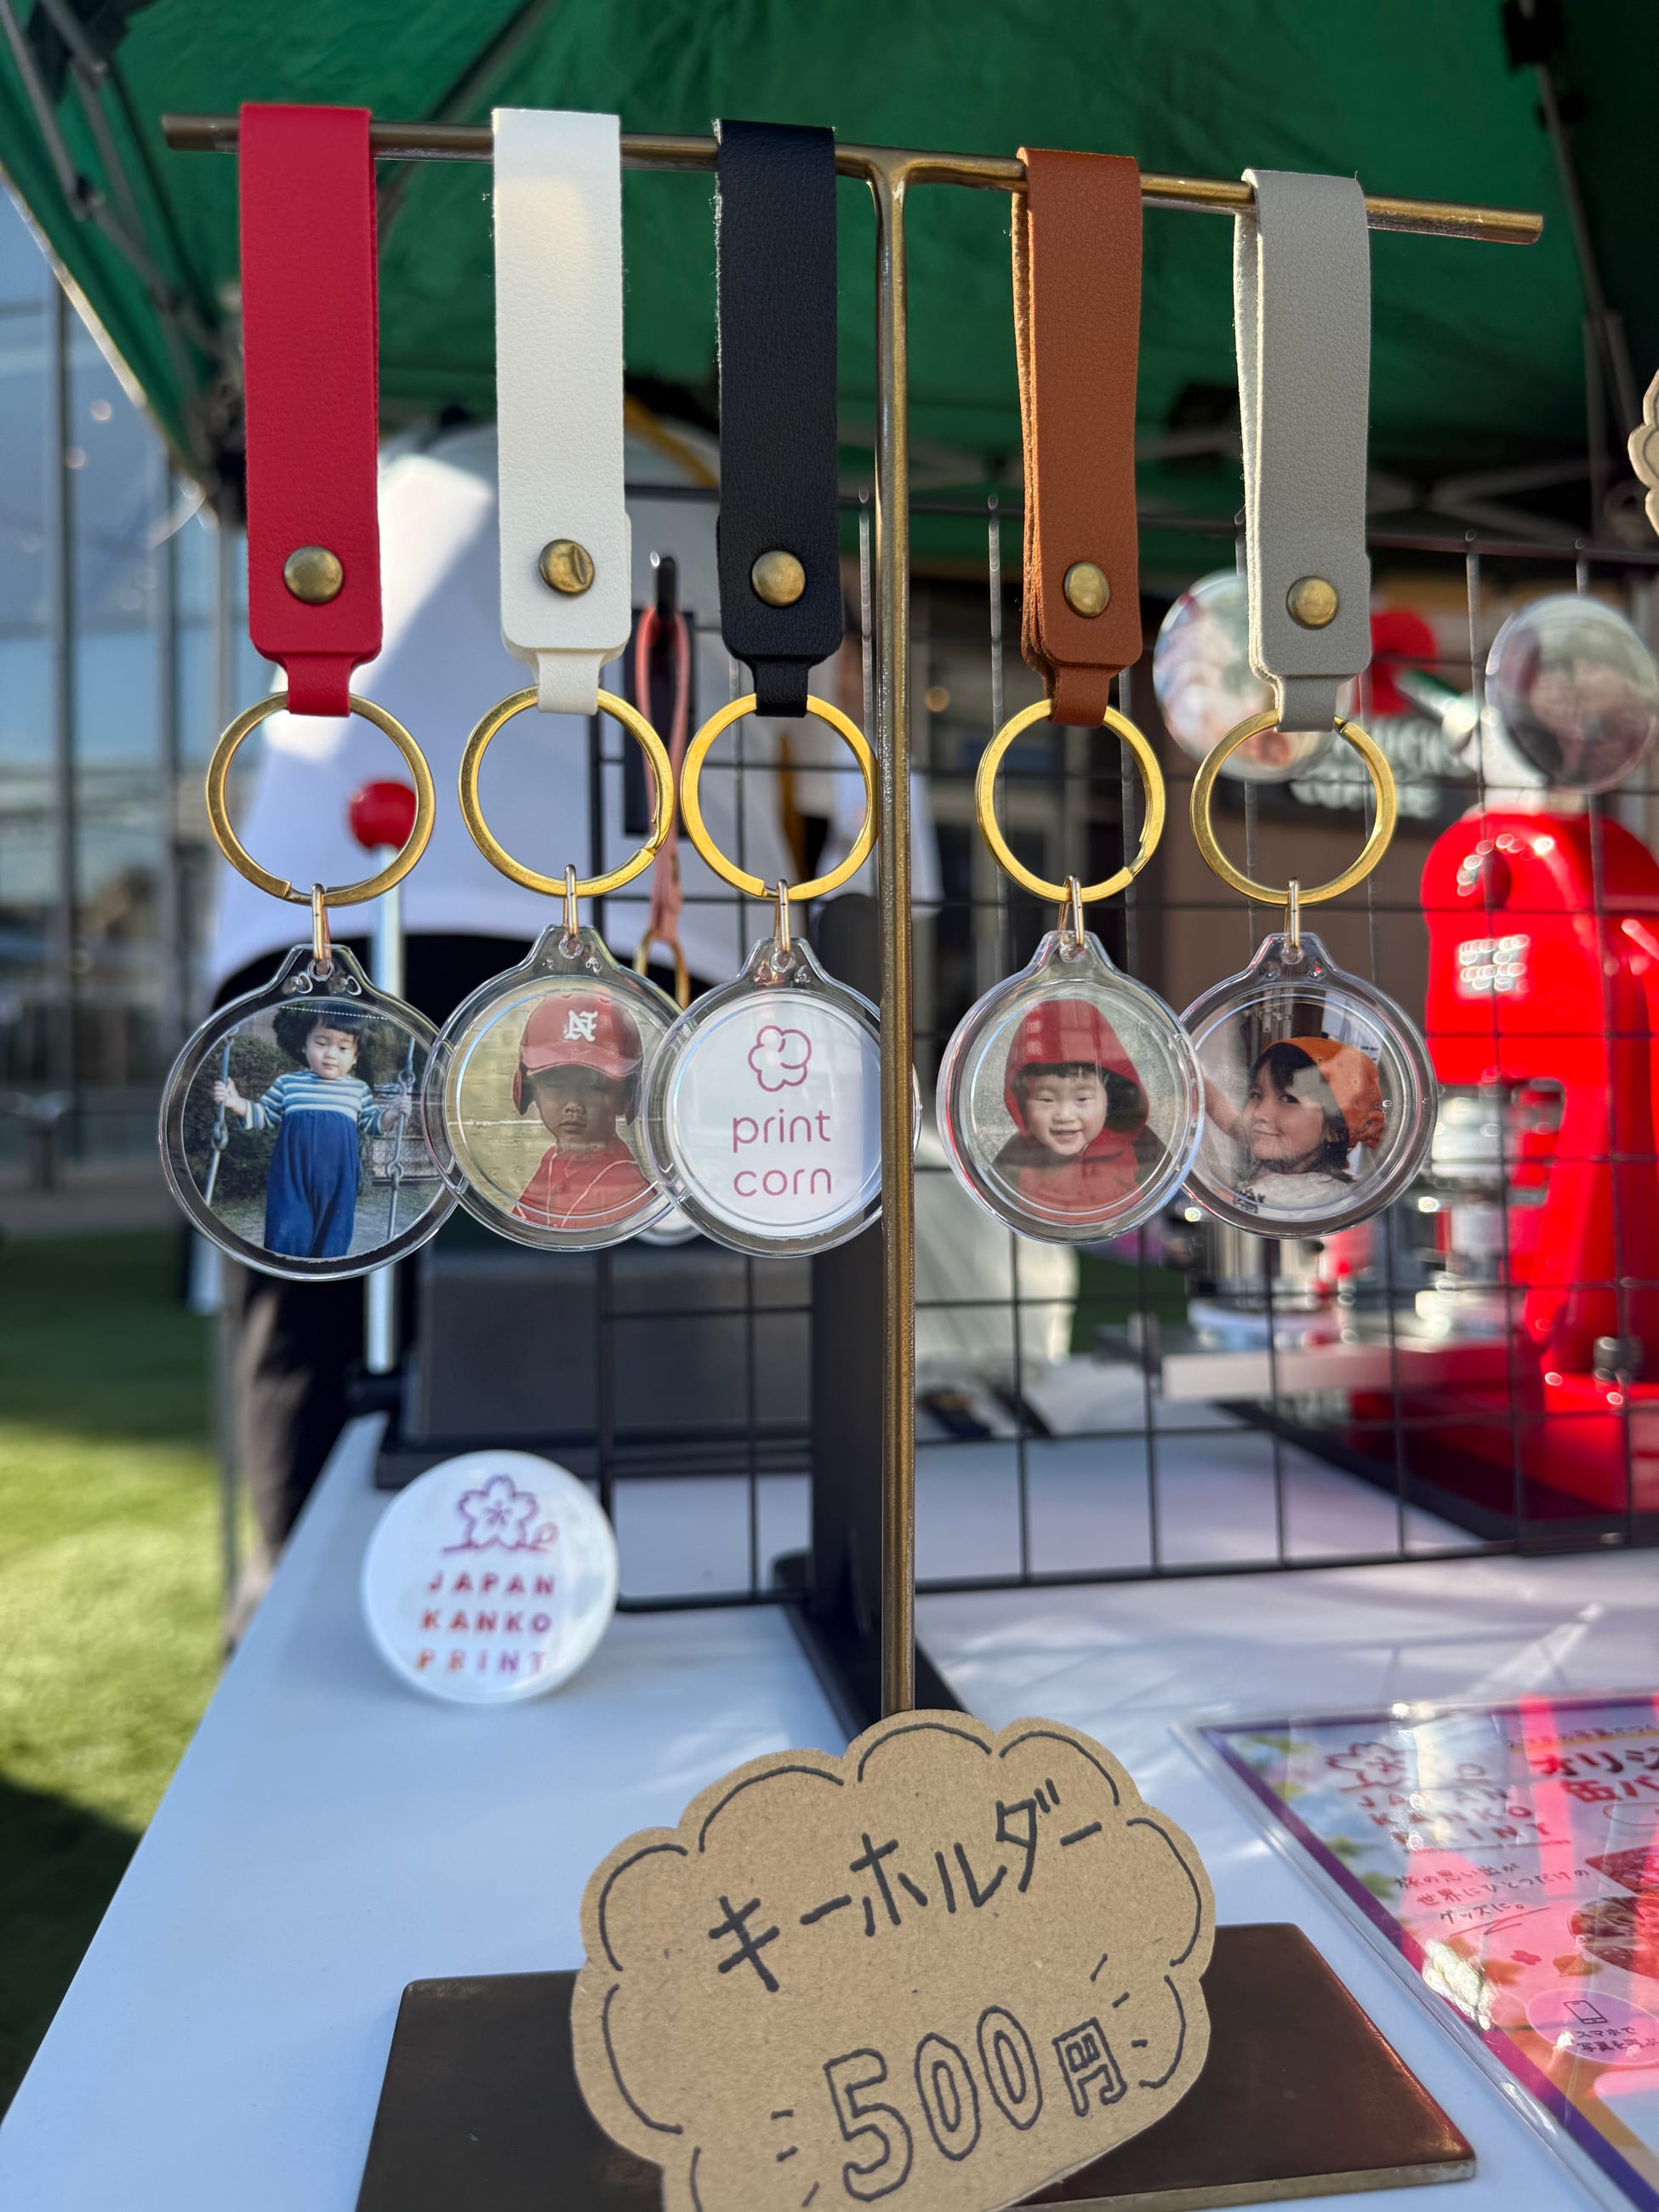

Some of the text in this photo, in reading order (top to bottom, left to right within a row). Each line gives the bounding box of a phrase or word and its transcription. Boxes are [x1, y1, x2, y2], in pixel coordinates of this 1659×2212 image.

[733, 1108, 831, 1154] print
[733, 1167, 832, 1197] corn
[428, 1571, 555, 1595] JAPAN
[421, 1610, 552, 1633] KANKO
[416, 1649, 546, 1673] PRINT
[708, 1779, 1103, 1993] キーホルダー
[822, 2004, 1128, 2201] 500円
